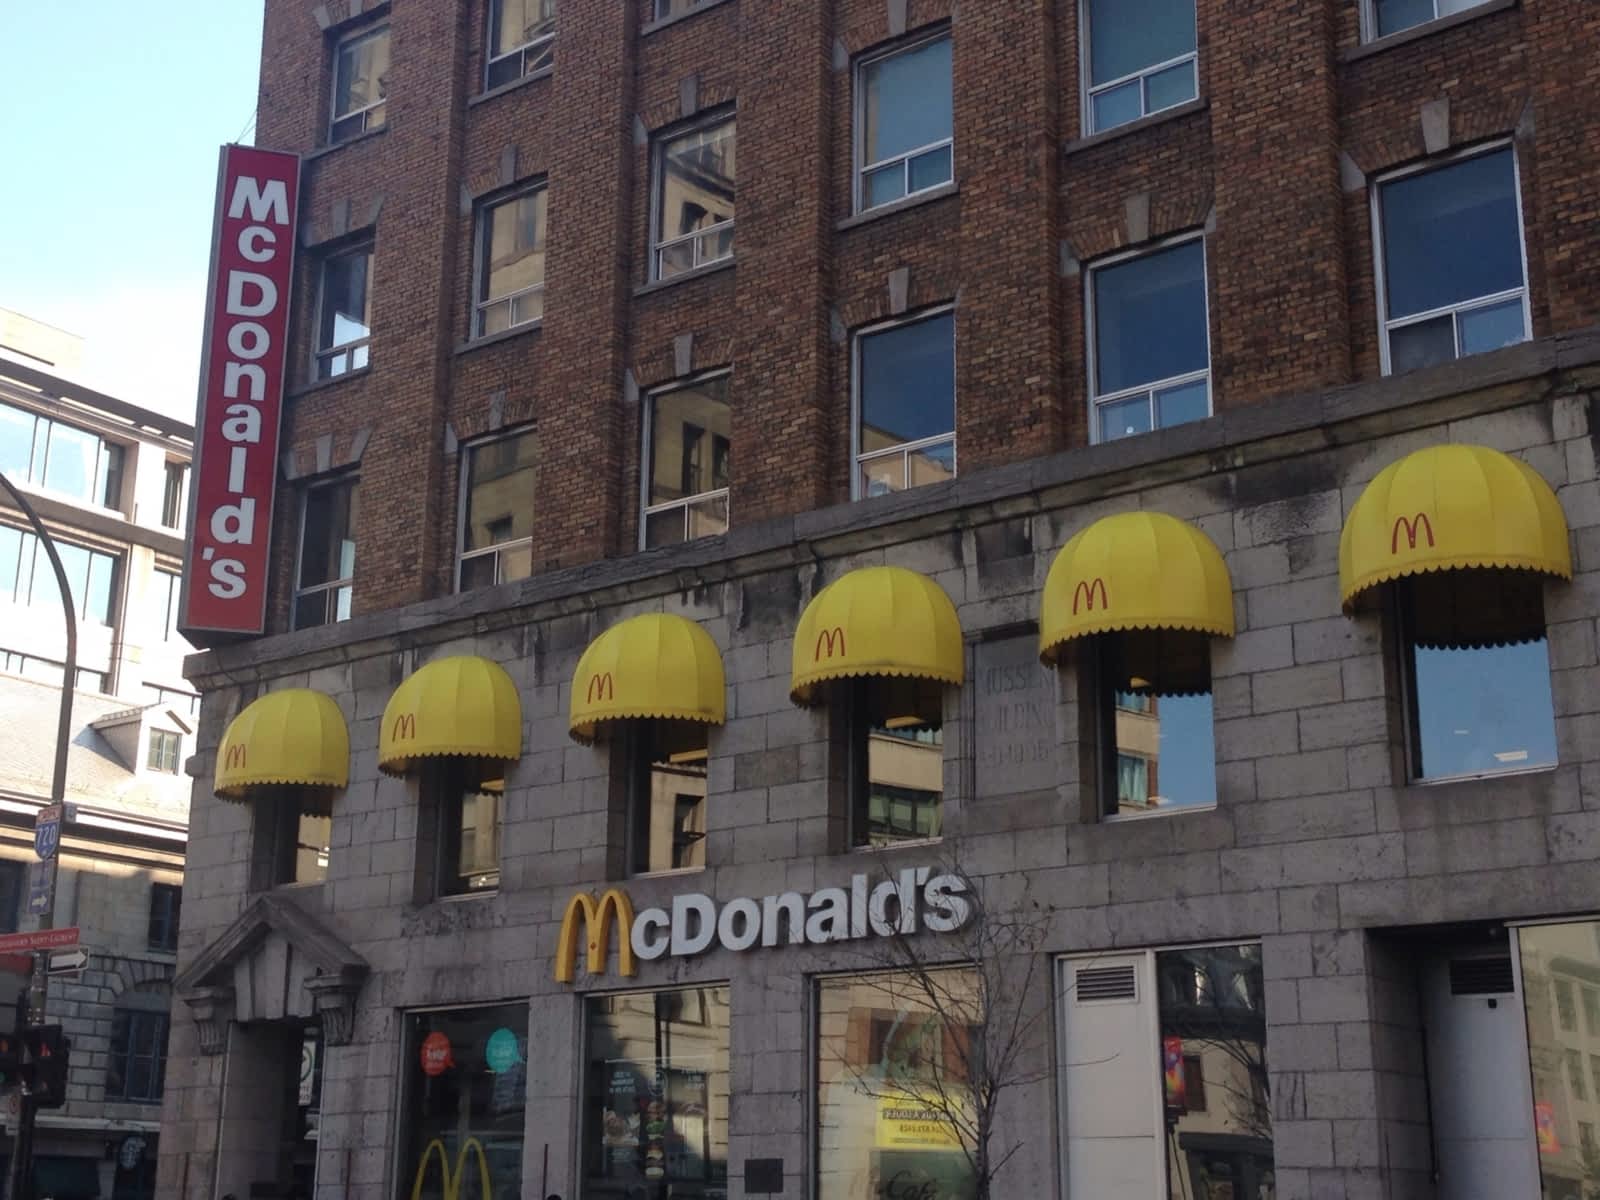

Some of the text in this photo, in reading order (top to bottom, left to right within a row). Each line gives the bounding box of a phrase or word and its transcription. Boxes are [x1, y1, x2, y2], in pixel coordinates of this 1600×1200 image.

[204, 175, 290, 598] McDonald's
[37, 824, 57, 849] 720
[554, 866, 970, 983] McDonald's
